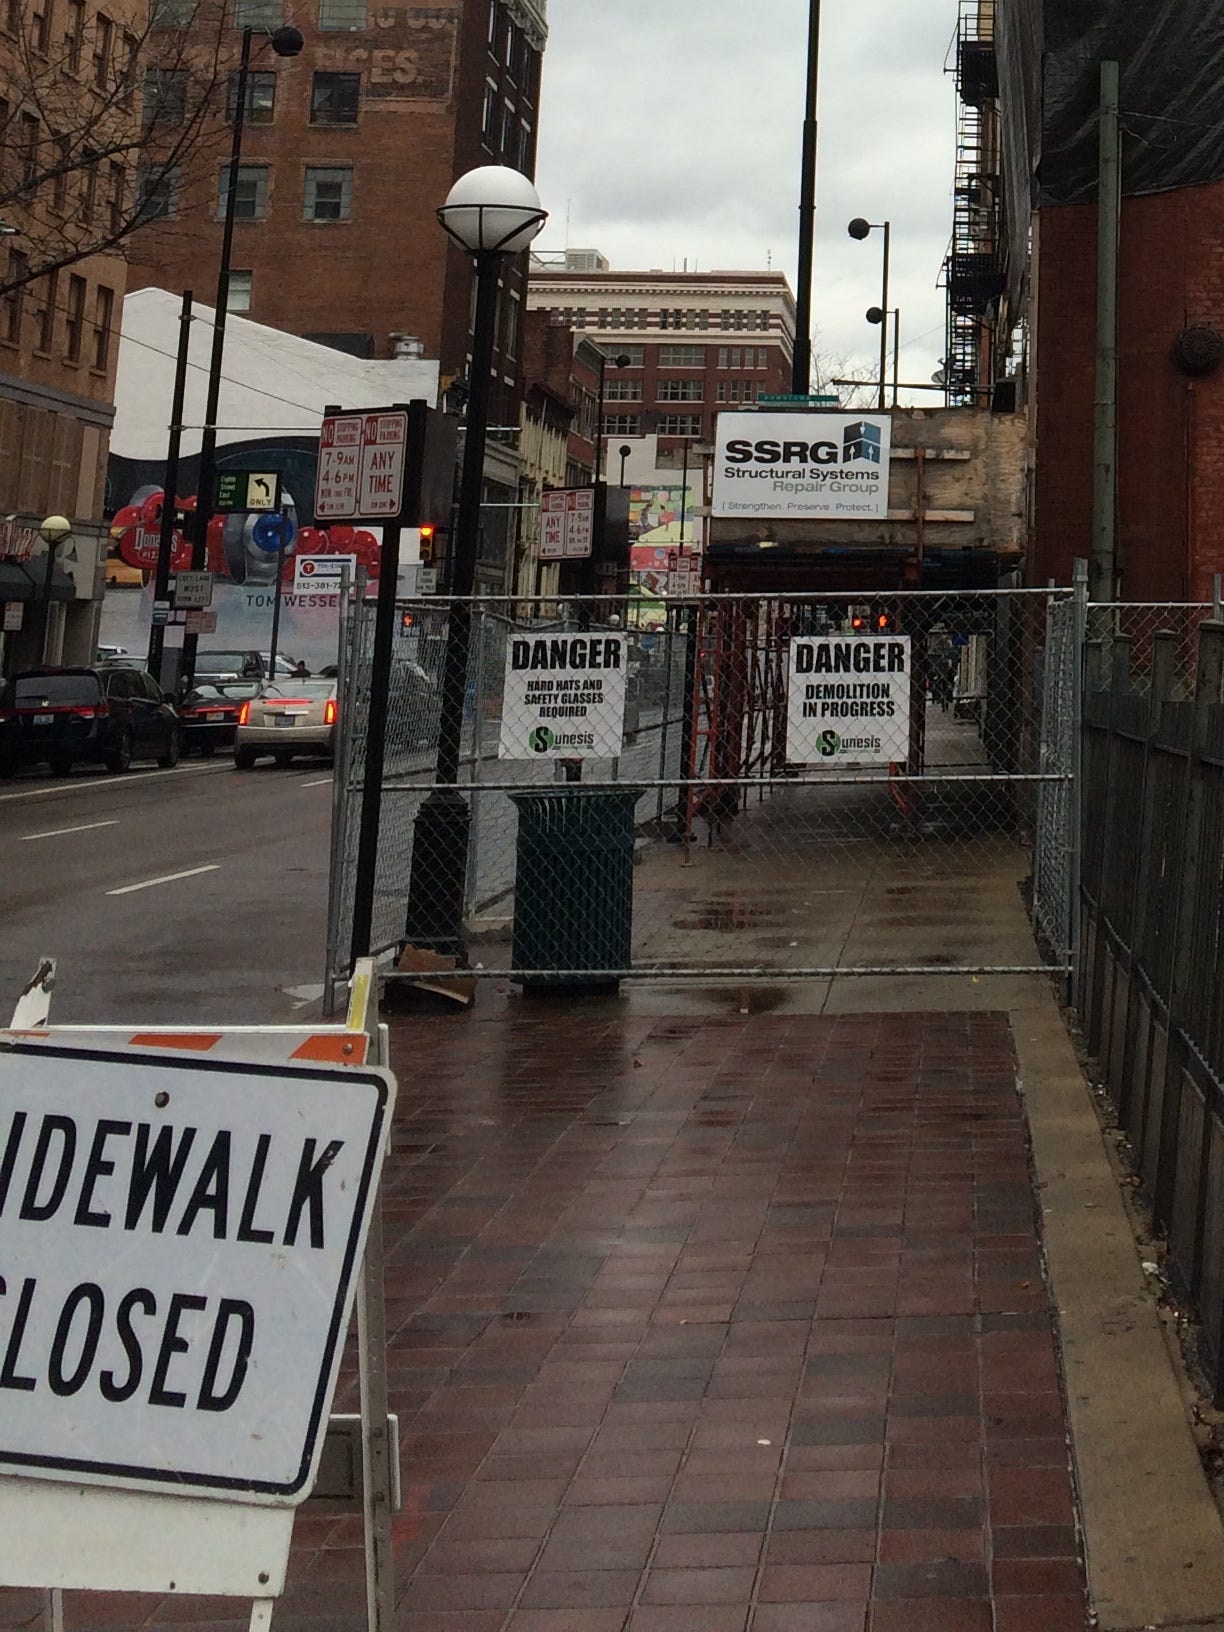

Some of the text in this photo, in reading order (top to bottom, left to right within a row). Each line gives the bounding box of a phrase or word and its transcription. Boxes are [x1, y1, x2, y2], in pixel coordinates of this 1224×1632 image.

[322, 423, 335, 445] NO
[365, 421, 377, 440] NO
[370, 450, 395, 471] ANY
[725, 439, 839, 465] SSRG
[724, 466, 880, 482] Structural Systems
[368, 474, 394, 494] TIME
[772, 481, 879, 496] Repair Group
[249, 498, 272, 506] ONLY
[835, 502, 873, 512] Protect.
[546, 515, 561, 529] ANY
[133, 527, 178, 553] Donas
[545, 531, 560, 544] TIME
[246, 594, 338, 607] TOM WESSE
[511, 638, 621, 670] DANGER
[795, 641, 905, 674] DANGER
[527, 679, 603, 692] HARD HATS AND
[805, 682, 891, 700] DEMOLITION
[524, 692, 604, 706] SAFETY GLASSES
[539, 705, 588, 719] REQUIRED
[802, 700, 895, 718] IN PROGRESS
[533, 725, 595, 753] Sunesis
[821, 729, 881, 757] Sunesis
[0, 1110, 346, 1250] IDEWALK
[0, 1273, 256, 1413] LOSED
